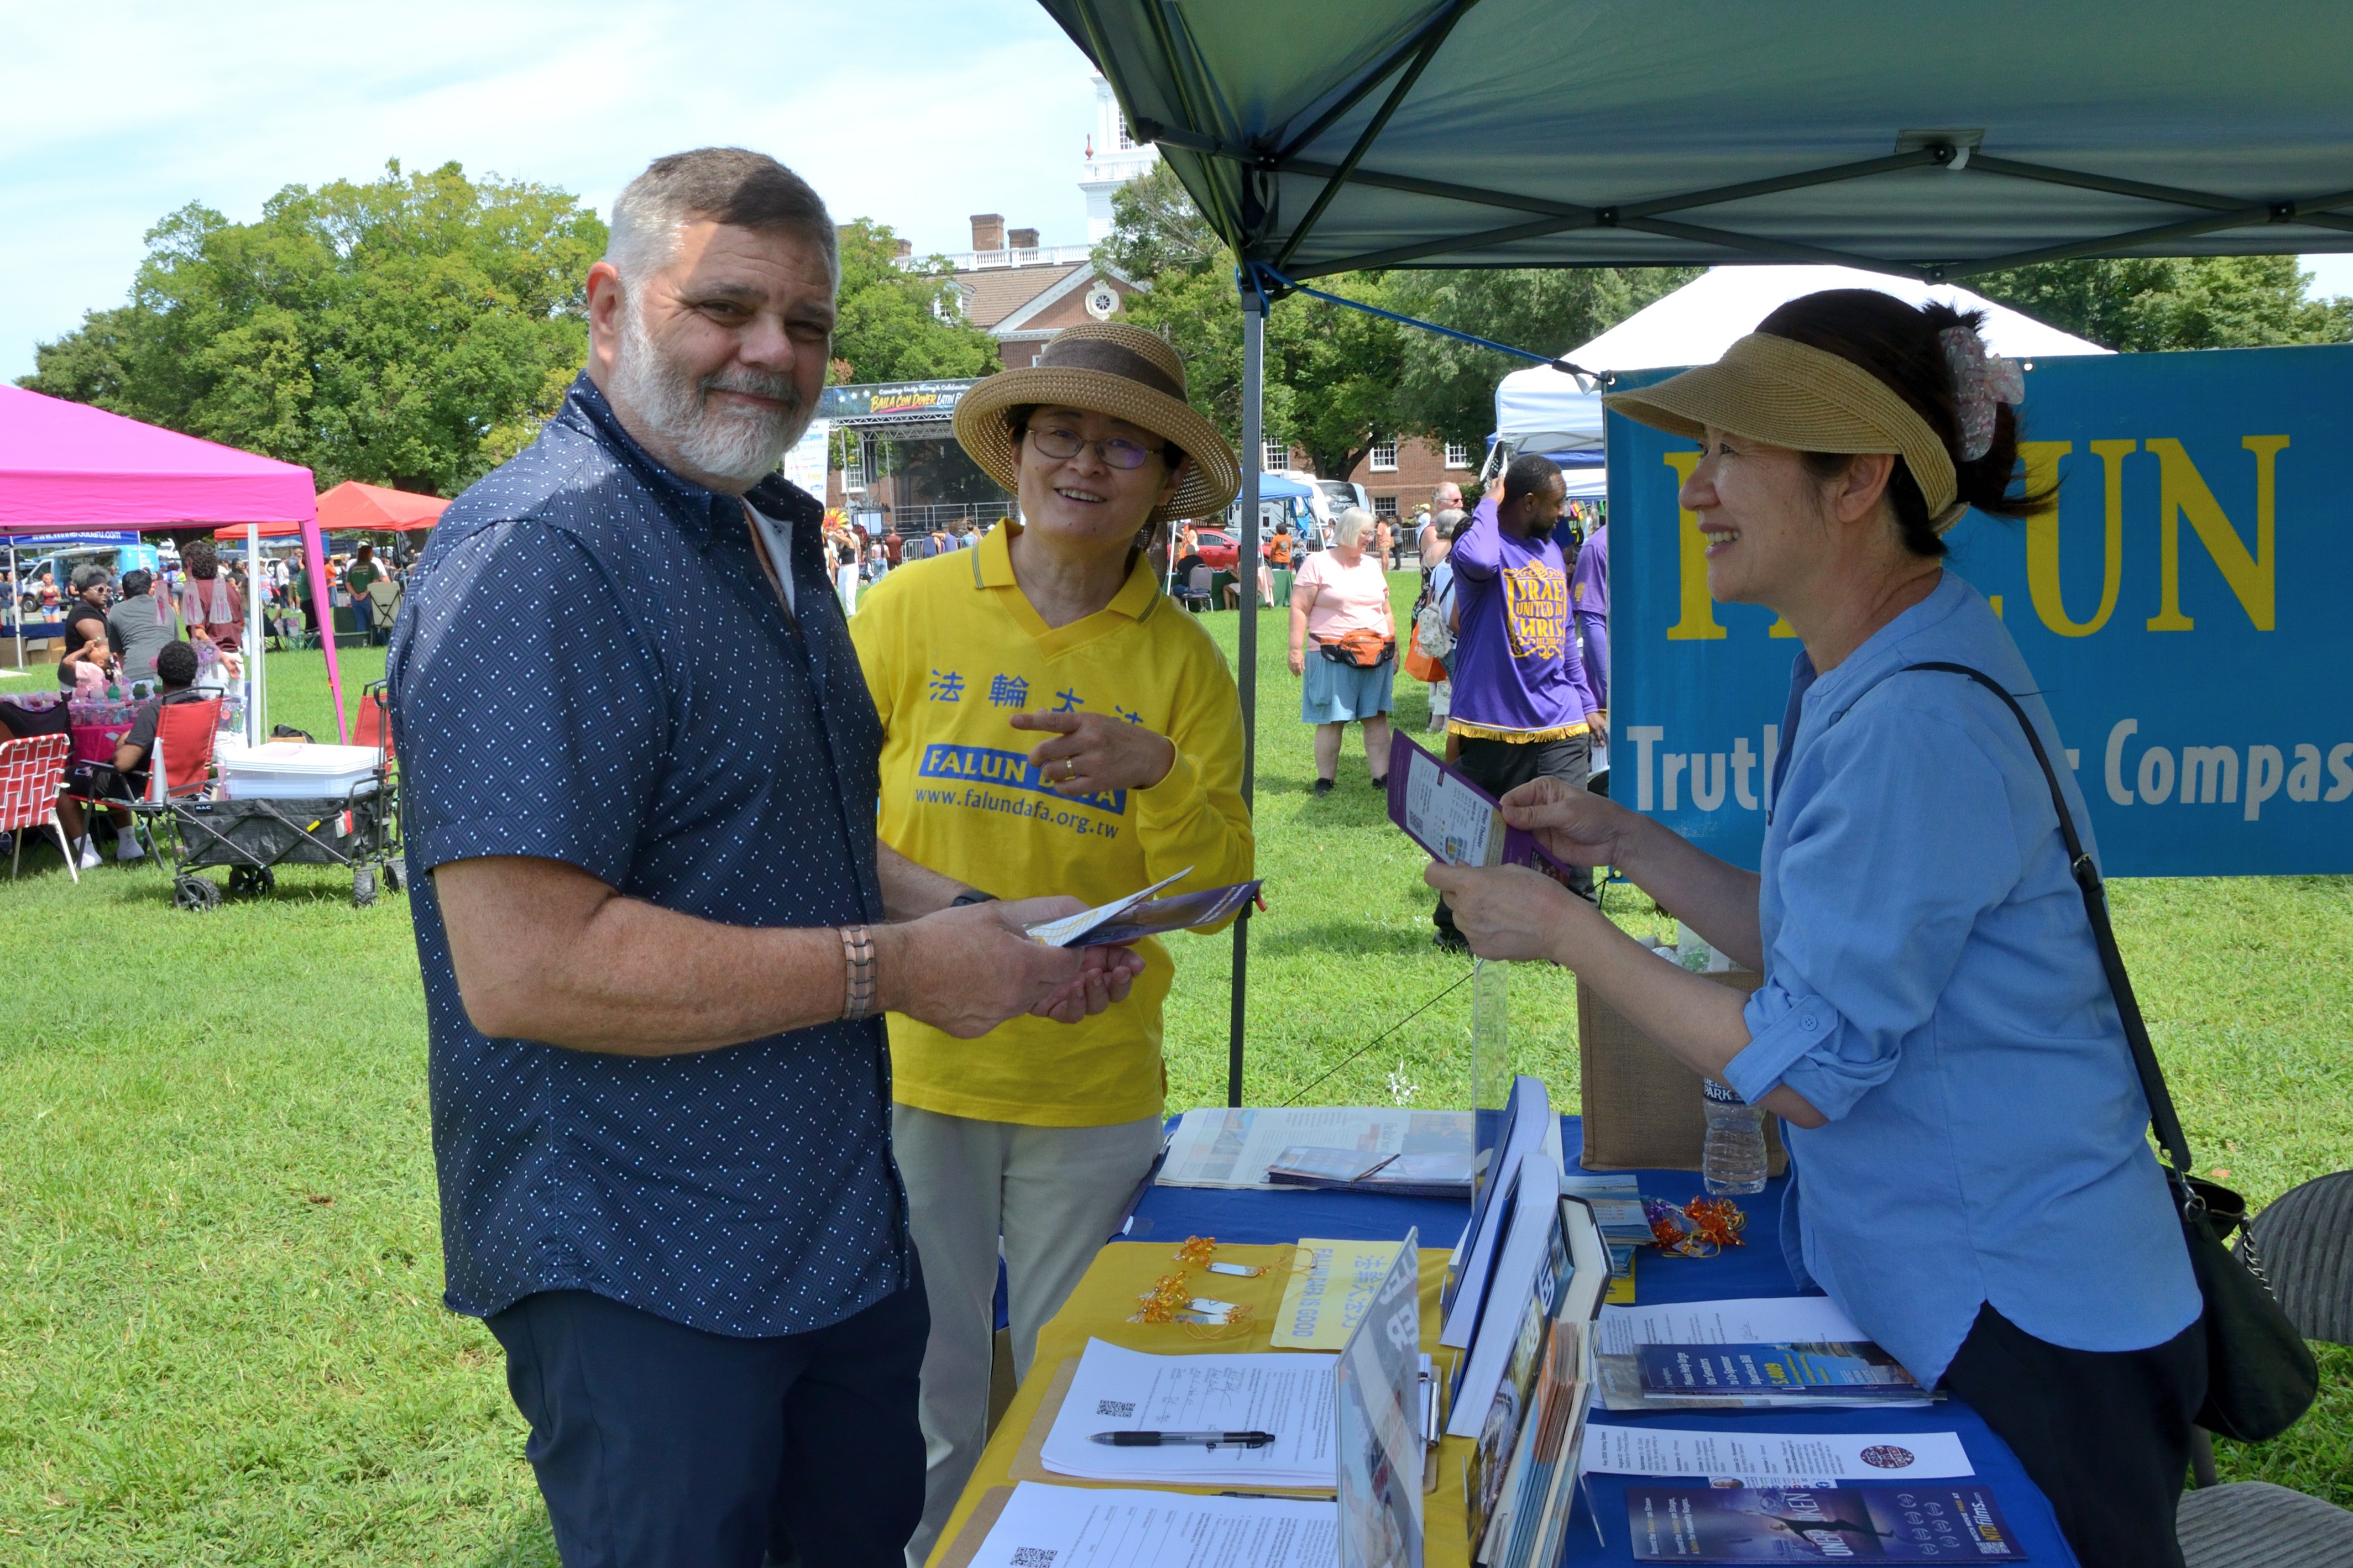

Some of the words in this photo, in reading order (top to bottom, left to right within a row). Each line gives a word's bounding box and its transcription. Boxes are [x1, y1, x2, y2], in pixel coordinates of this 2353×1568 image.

[912, 392, 937, 407] DOVER
[937, 393, 955, 406] LATIN
[1516, 601, 1554, 617] UNITED
[1555, 602, 1564, 617] IN
[928, 750, 1027, 783] FALUN
[2105, 718, 2353, 821] Compas
[915, 788, 1118, 839] www.falundafa.org.tw
[1481, 807, 1489, 825] Miller
[1477, 825, 1486, 849] Theater
[1704, 1085, 1732, 1101] PARK
[1309, 1248, 1334, 1276] FALUN
[1303, 1278, 1327, 1297] DAFA
[1292, 1309, 1319, 1337] GOOD
[1677, 1352, 1690, 1364] Urge
[1739, 1355, 1753, 1363] Bill
[1679, 1364, 1692, 1373] Help
[1700, 1358, 1714, 1377] Senators
[1720, 1355, 1737, 1380] Co-Sponsor
[1745, 1364, 1764, 1385] Bipartisan
[1683, 1373, 1695, 1385] Please
[1955, 1500, 1965, 1512] FREE
[1960, 1512, 1973, 1527] MOVIE
[1968, 1527, 1981, 1541] WATCH
